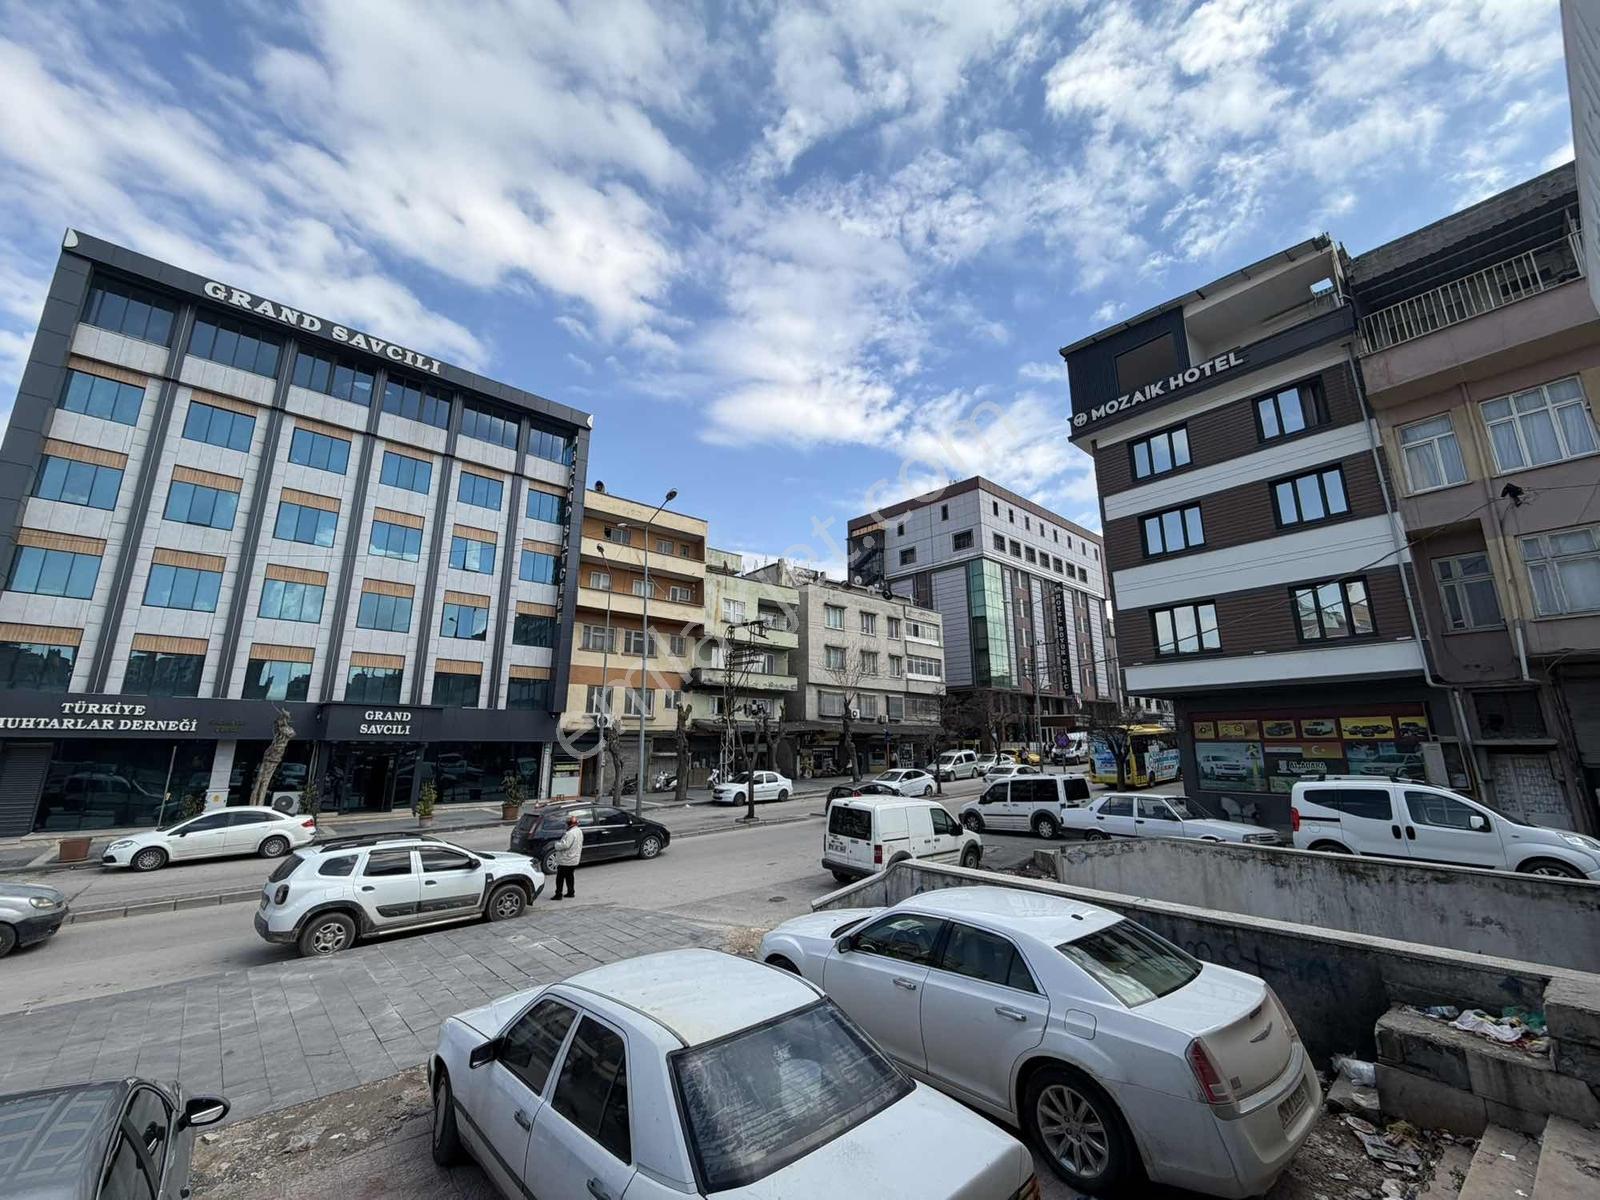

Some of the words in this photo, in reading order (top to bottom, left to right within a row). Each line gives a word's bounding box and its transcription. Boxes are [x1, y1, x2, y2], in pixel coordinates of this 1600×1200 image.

[204, 281, 322, 332] GRAND
[331, 325, 441, 375] SAVCILI
[1090, 380, 1165, 421] MOZAIK
[1169, 352, 1244, 391] HOTEL
[61, 701, 146, 716] TÜRKİYE
[364, 710, 411, 722] GRAND
[118, 718, 198, 732] DERNEĞİ
[359, 724, 411, 735] SAVCILI
